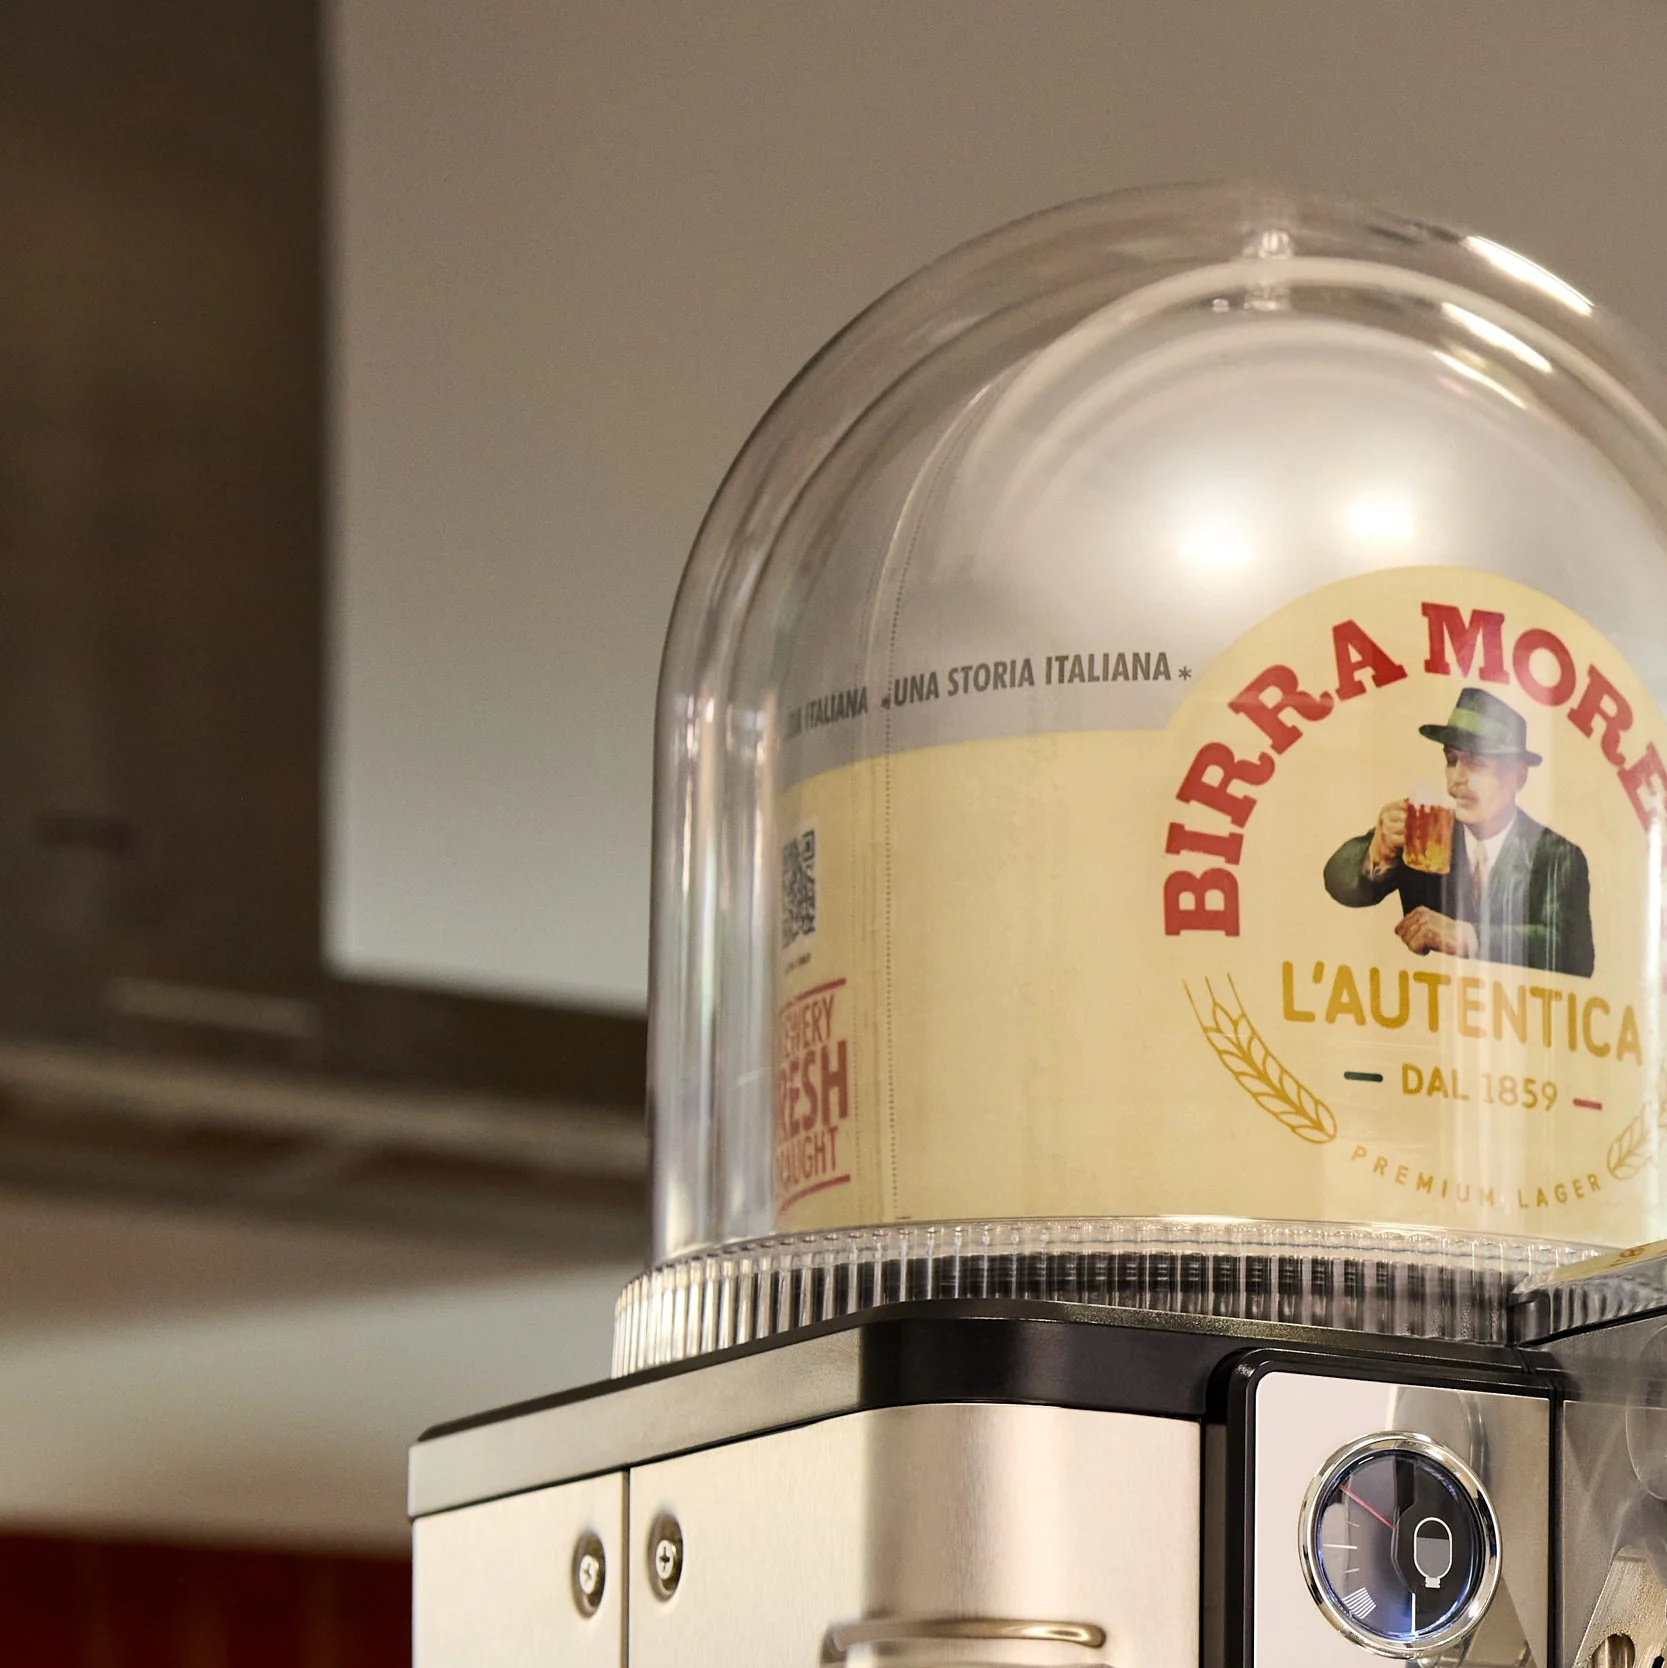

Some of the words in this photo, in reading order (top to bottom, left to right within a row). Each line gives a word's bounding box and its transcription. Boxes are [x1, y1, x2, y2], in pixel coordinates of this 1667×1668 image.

[894, 671, 939, 706] UNA
[947, 657, 1036, 697] STORIA
[1044, 651, 1172, 686] ITALIANA
[805, 687, 868, 731] ITALIANA
[1163, 619, 1408, 937] BIRRA
[1282, 960, 1643, 1066] L'AUTENTICA
[1402, 1063, 1469, 1101] DAL
[1481, 1071, 1559, 1112] 1859
[1351, 1145, 1495, 1208] PREMIUM
[1519, 1174, 1601, 1210] LAGER
